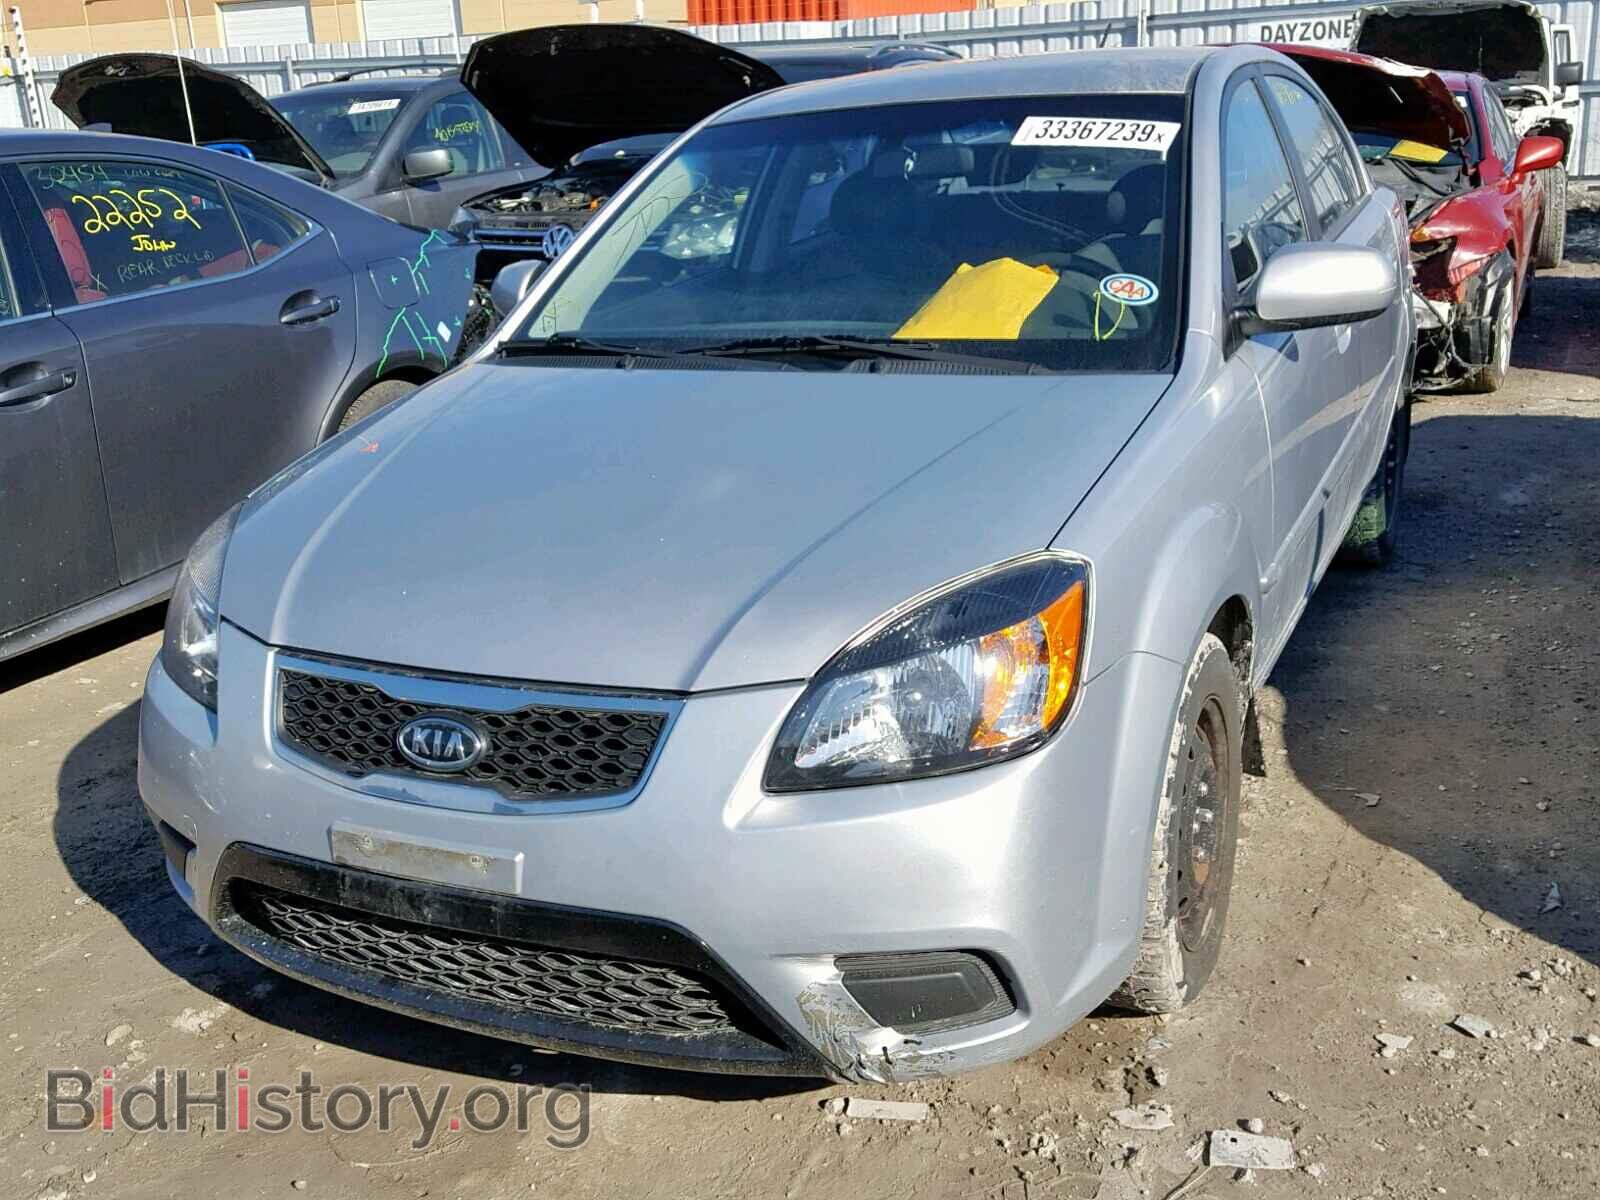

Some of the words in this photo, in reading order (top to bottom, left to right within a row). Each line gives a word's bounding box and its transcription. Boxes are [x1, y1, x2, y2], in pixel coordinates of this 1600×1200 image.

[1260, 19, 1353, 43] DAYZONE
[71, 188, 202, 234] 22252
[1109, 280, 1145, 298] CAA
[411, 727, 465, 760] KIA
